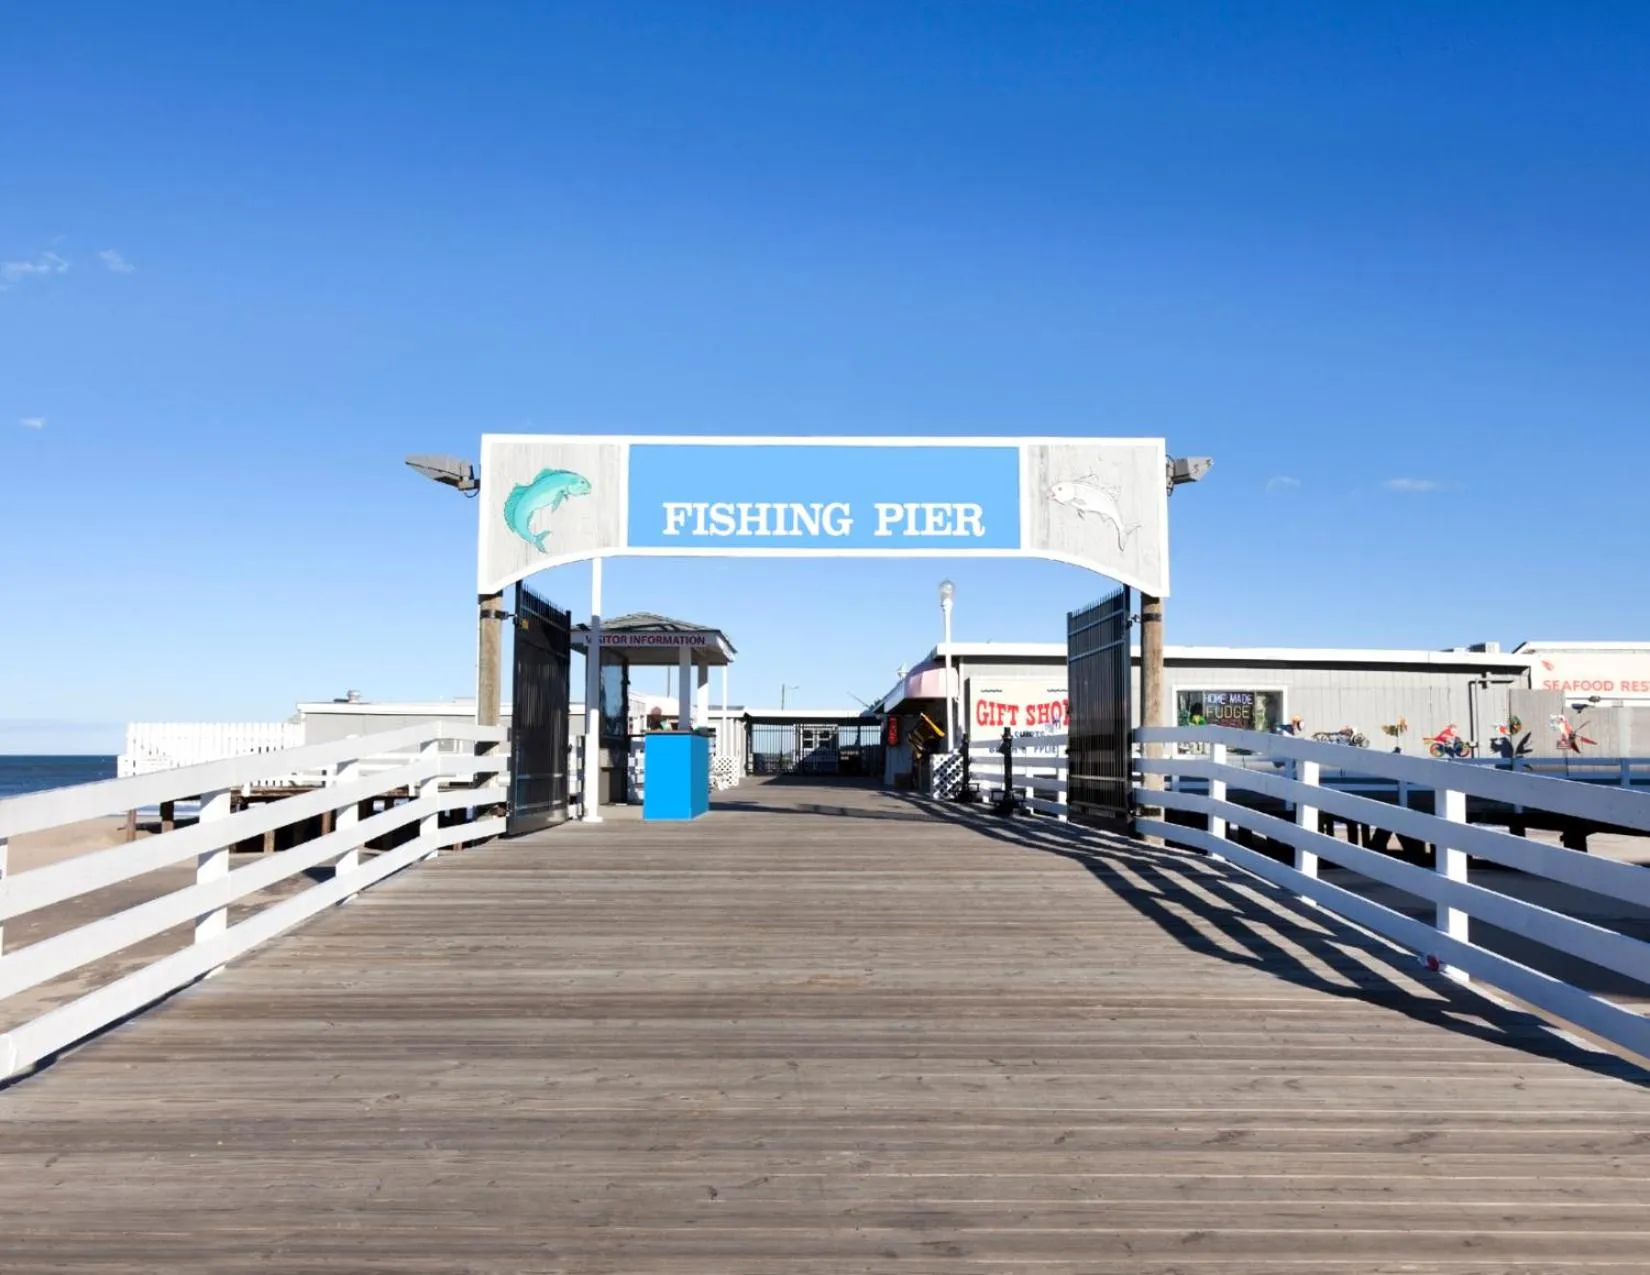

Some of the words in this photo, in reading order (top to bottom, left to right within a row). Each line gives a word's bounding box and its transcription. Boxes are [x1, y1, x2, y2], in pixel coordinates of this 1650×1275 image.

[662, 501, 853, 538] FISHING
[874, 501, 985, 538] PIER
[585, 634, 627, 645] VSITOR
[630, 634, 705, 645] INFORMATION
[1543, 680, 1615, 692] SEAFOOD
[1229, 693, 1253, 705] MADE
[976, 699, 1019, 726] GIFT
[1206, 705, 1250, 719] FUDGE
